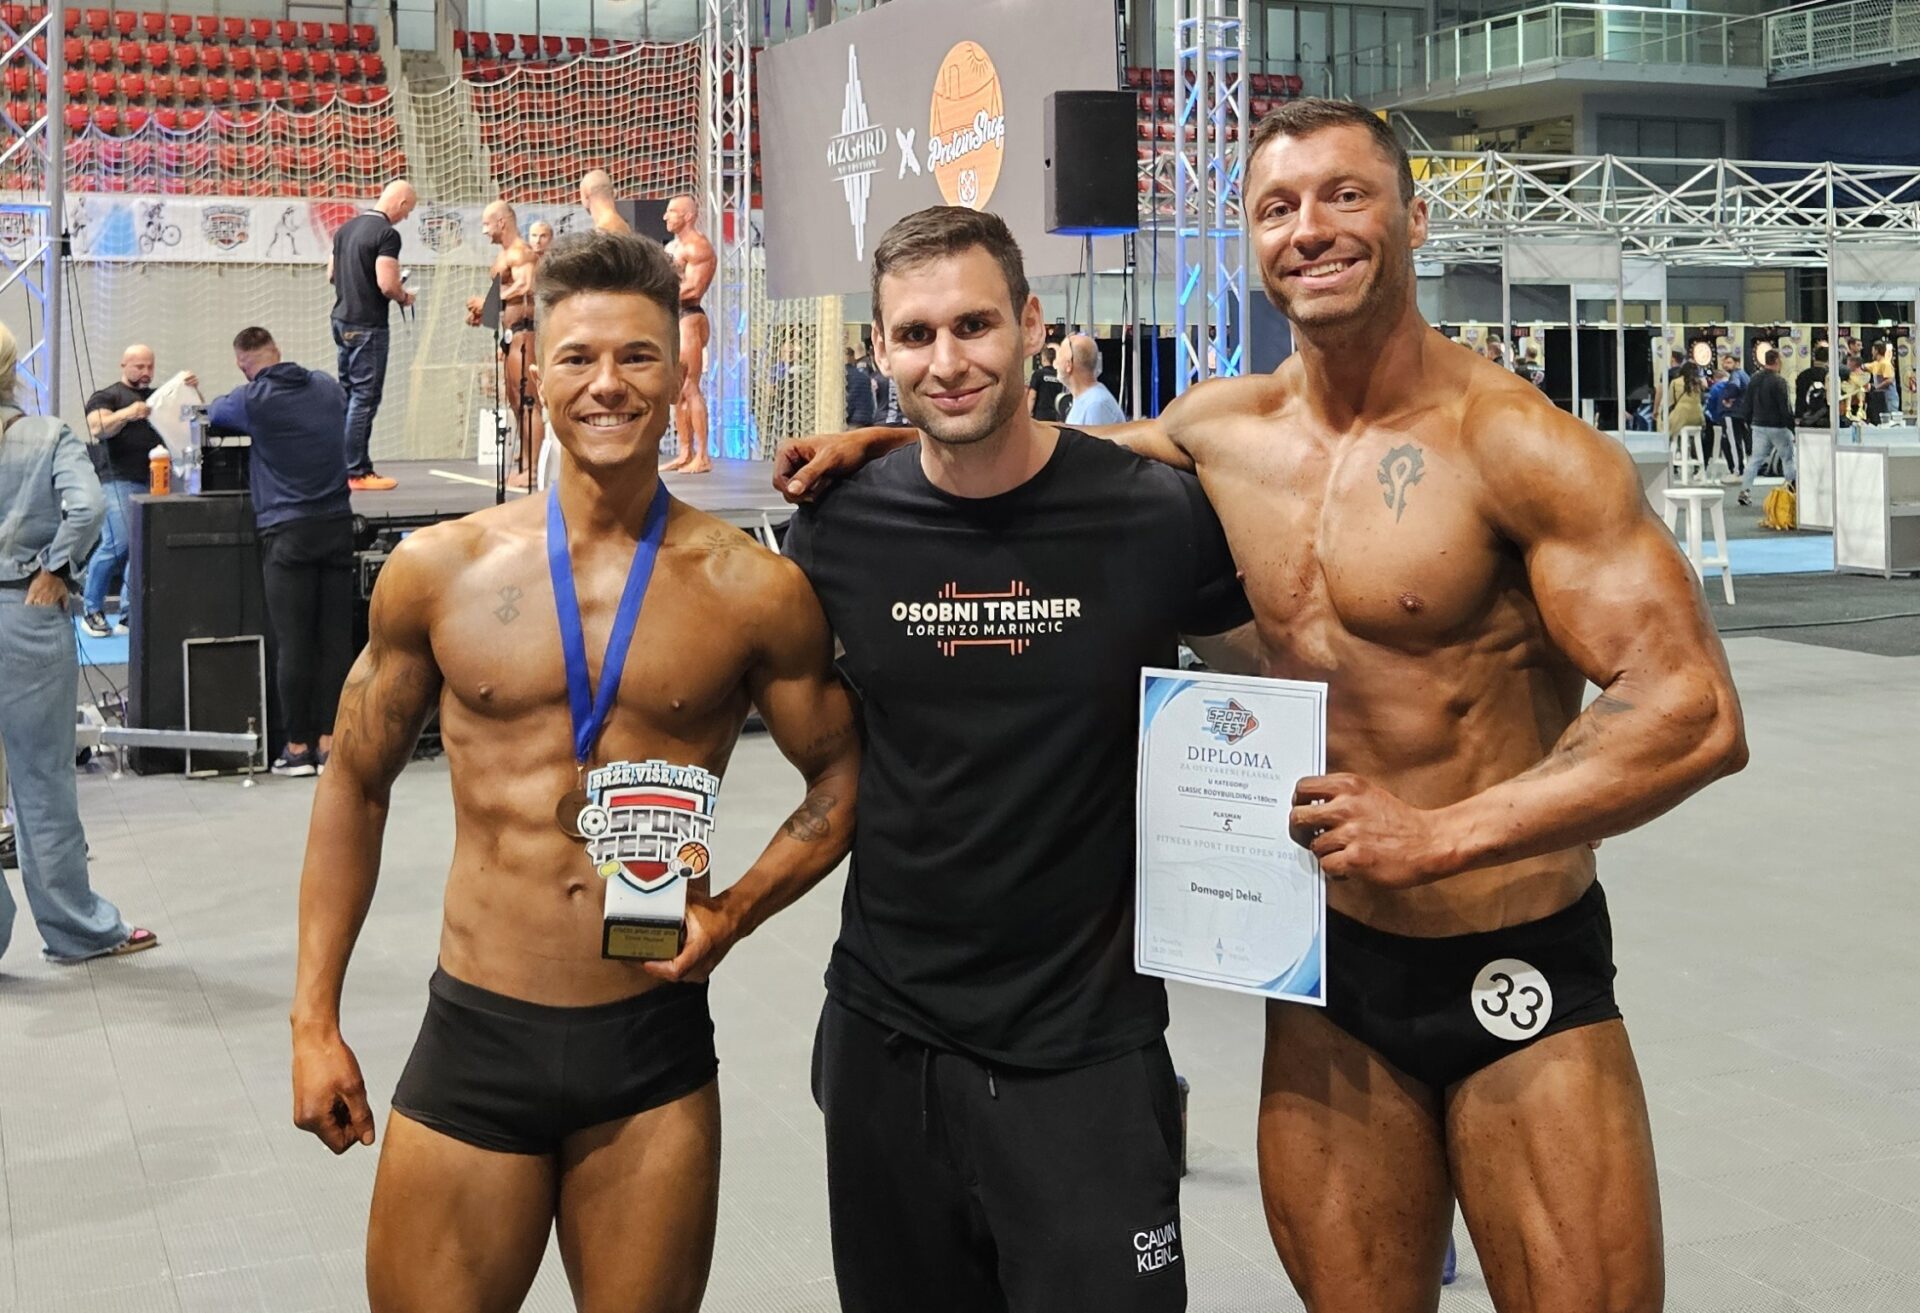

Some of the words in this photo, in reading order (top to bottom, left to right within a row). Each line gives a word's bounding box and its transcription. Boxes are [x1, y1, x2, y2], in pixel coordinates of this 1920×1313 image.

[891, 602, 979, 622] OSOBNI
[984, 598, 1081, 621] TRENER
[906, 624, 979, 636] LORENZO
[984, 621, 1064, 636] MARINCIC
[1208, 709, 1250, 723] SPORT
[1213, 721, 1245, 734] FEST
[1187, 745, 1273, 769] DIPLOMA
[592, 765, 634, 790] BRŽE,
[636, 763, 675, 786] VIŠE,
[675, 769, 716, 796] JAČE!
[1177, 785, 1202, 795] CLASSIC
[1203, 788, 1252, 801] BODYBUILDING
[610, 808, 712, 841] SPORT
[1213, 811, 1242, 820] PLASMAN
[596, 834, 679, 862] FEST
[1156, 834, 1191, 846] FITNESS
[1194, 838, 1222, 850] SPORT
[1225, 843, 1246, 854] FEST
[1249, 847, 1274, 857] OPEN
[1190, 882, 1234, 901] Domagoj
[1236, 889, 1263, 903] Delač
[1481, 972, 1544, 1031] 33
[1133, 1221, 1177, 1251] CALVIN
